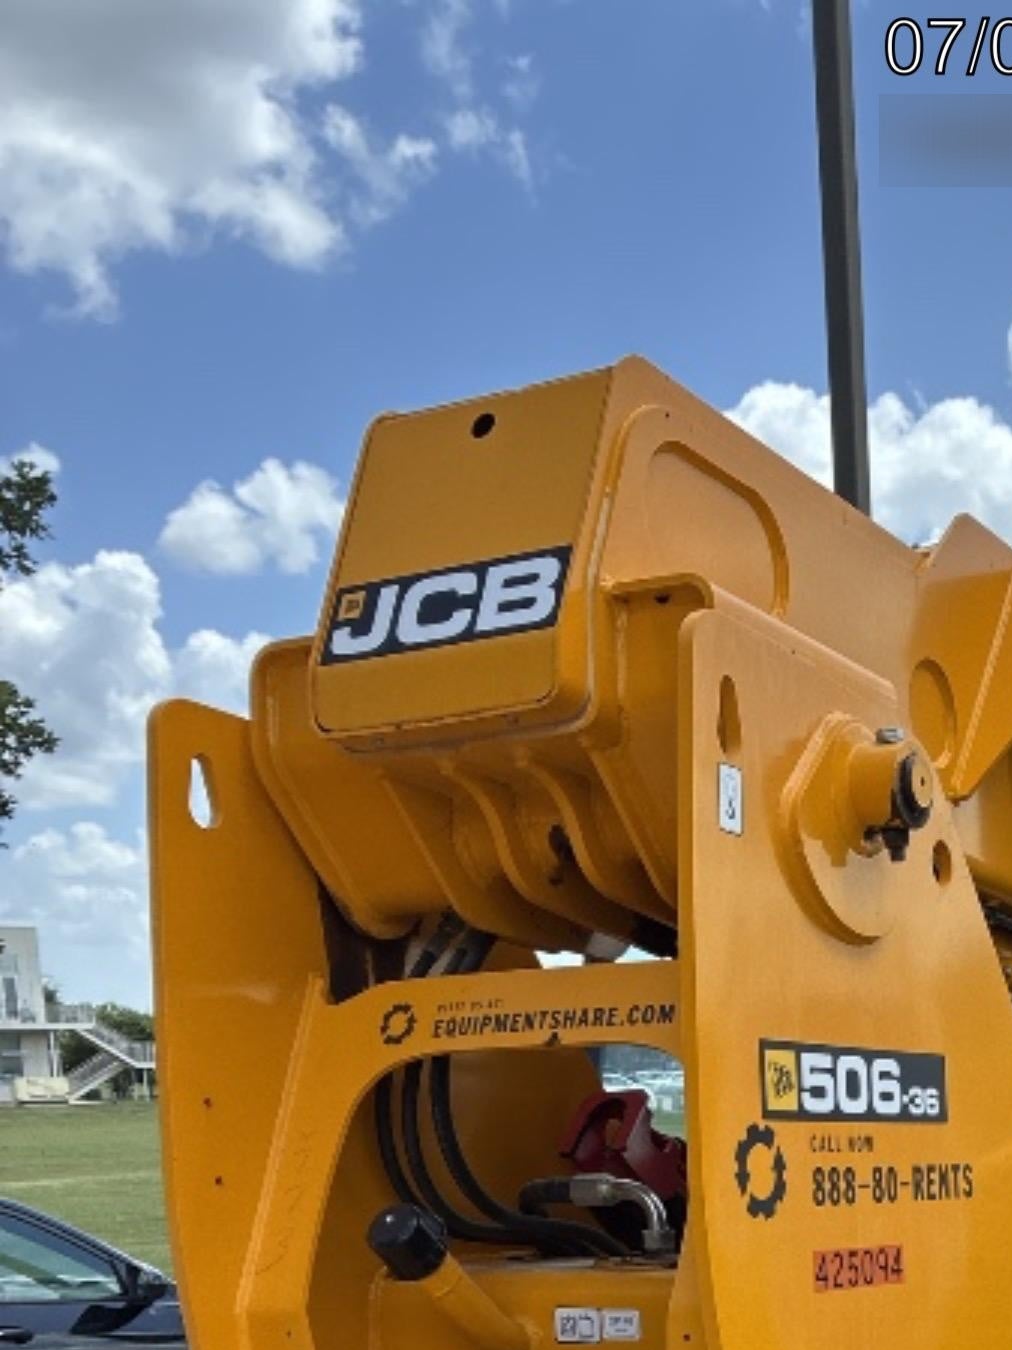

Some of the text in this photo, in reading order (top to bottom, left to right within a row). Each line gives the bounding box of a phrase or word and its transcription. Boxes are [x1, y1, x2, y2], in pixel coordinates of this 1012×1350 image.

[331, 555, 562, 656] JCB
[431, 1003, 676, 1039] EQUIPMENTSHARE.COM
[811, 1163, 974, 1207] 888-80-RENTS
[814, 1248, 903, 1289] 425094
